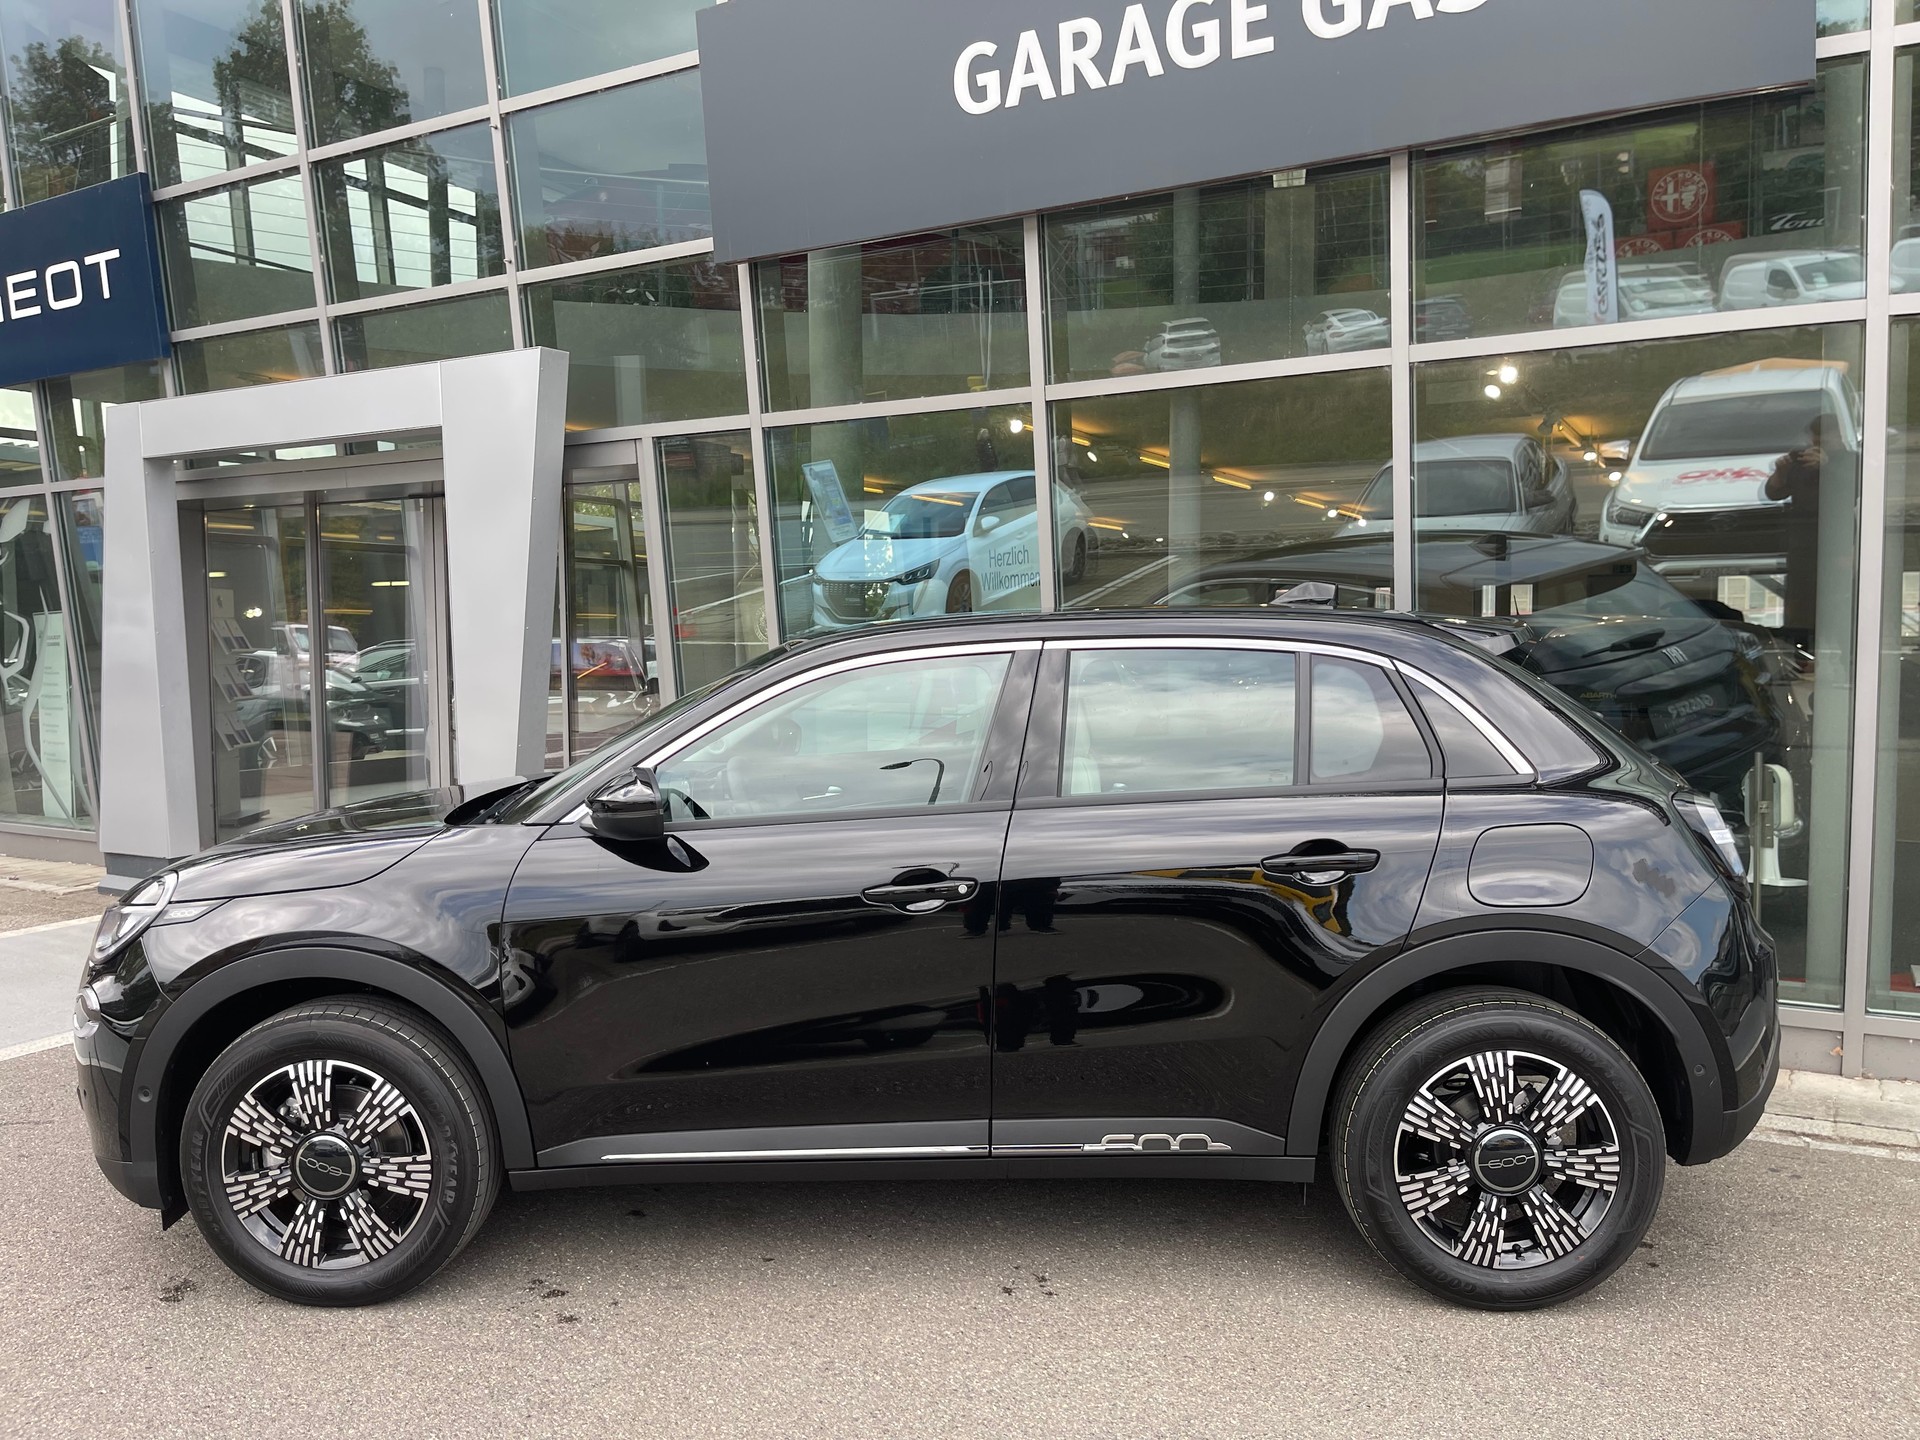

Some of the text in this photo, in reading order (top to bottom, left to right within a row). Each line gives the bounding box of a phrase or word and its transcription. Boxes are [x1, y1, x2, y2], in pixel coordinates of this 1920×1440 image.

[953, 0, 1276, 115] GARAGE
[0, 248, 121, 323] EOT
[988, 545, 1030, 569] Herzlich
[980, 570, 1042, 592] Willkommen
[305, 1157, 342, 1177] 600
[1488, 1155, 1527, 1169] 600
